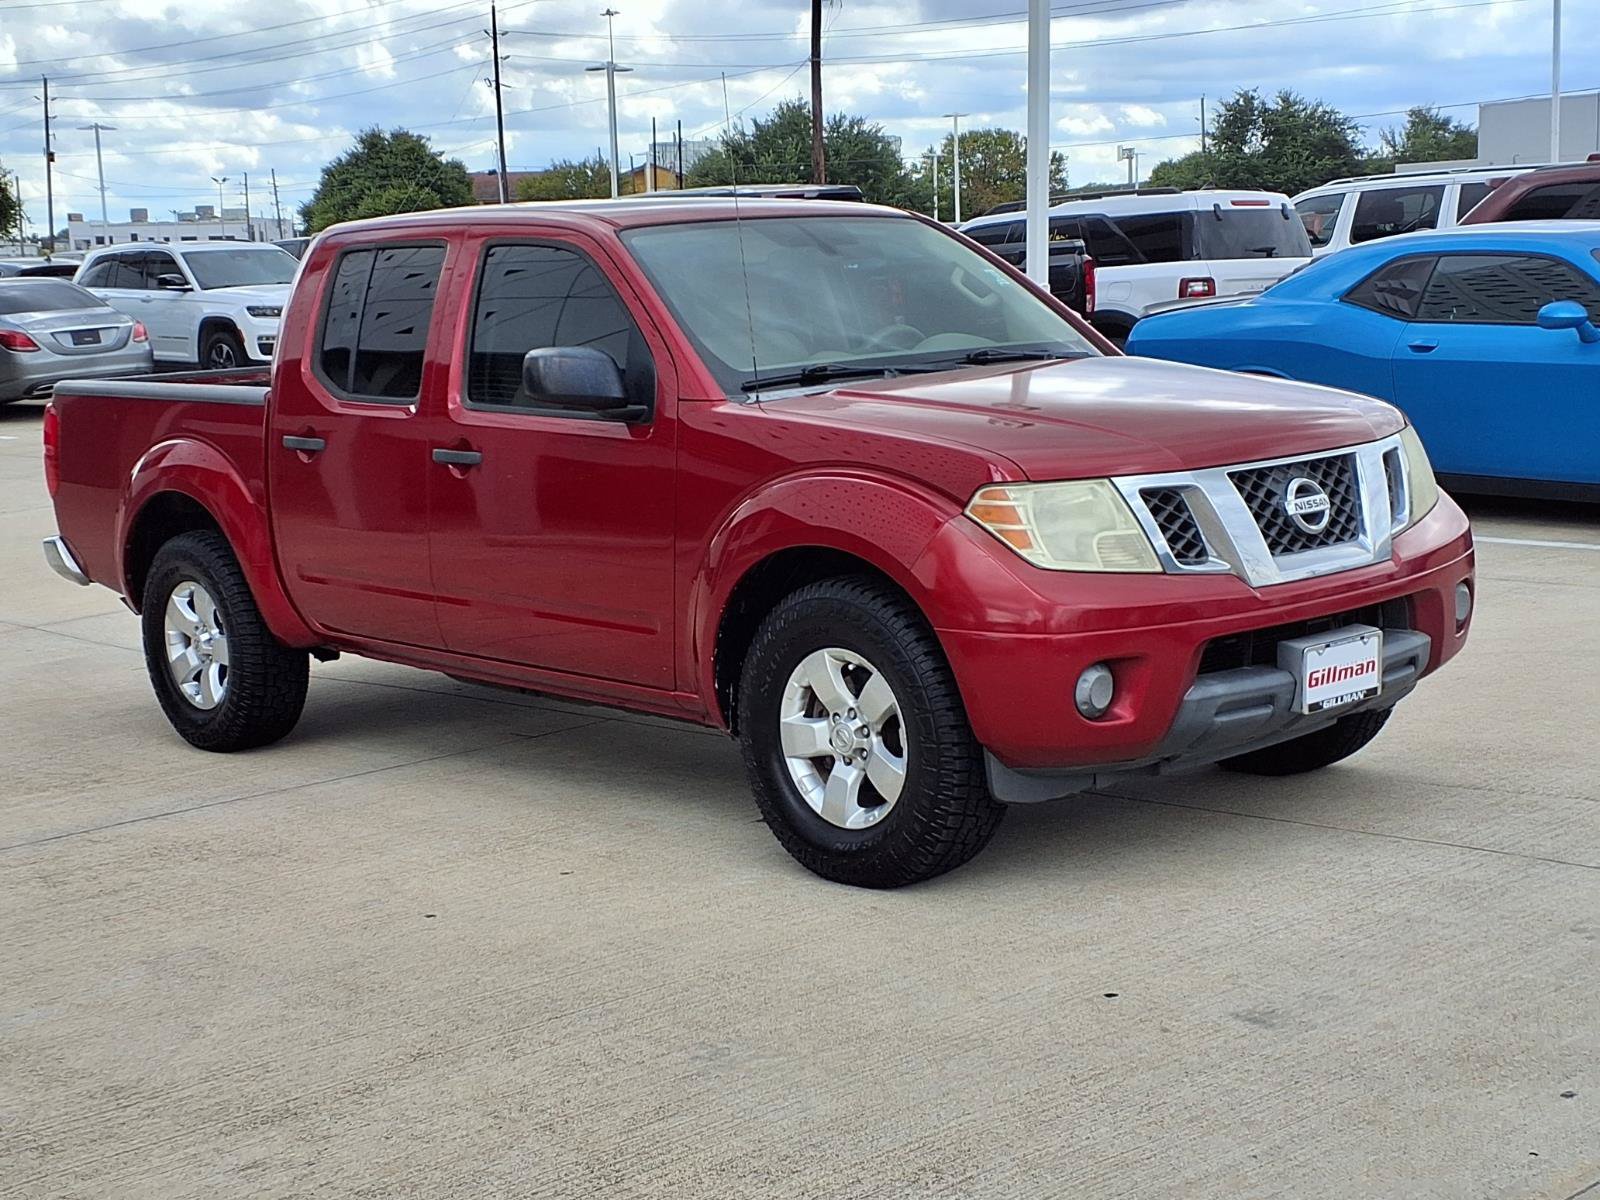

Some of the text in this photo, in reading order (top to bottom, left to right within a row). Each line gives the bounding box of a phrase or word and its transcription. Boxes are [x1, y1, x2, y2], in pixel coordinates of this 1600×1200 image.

[1294, 498, 1329, 512] NISSAN
[1308, 659, 1376, 688] Gillman
[1322, 690, 1365, 709] GILLMAN
